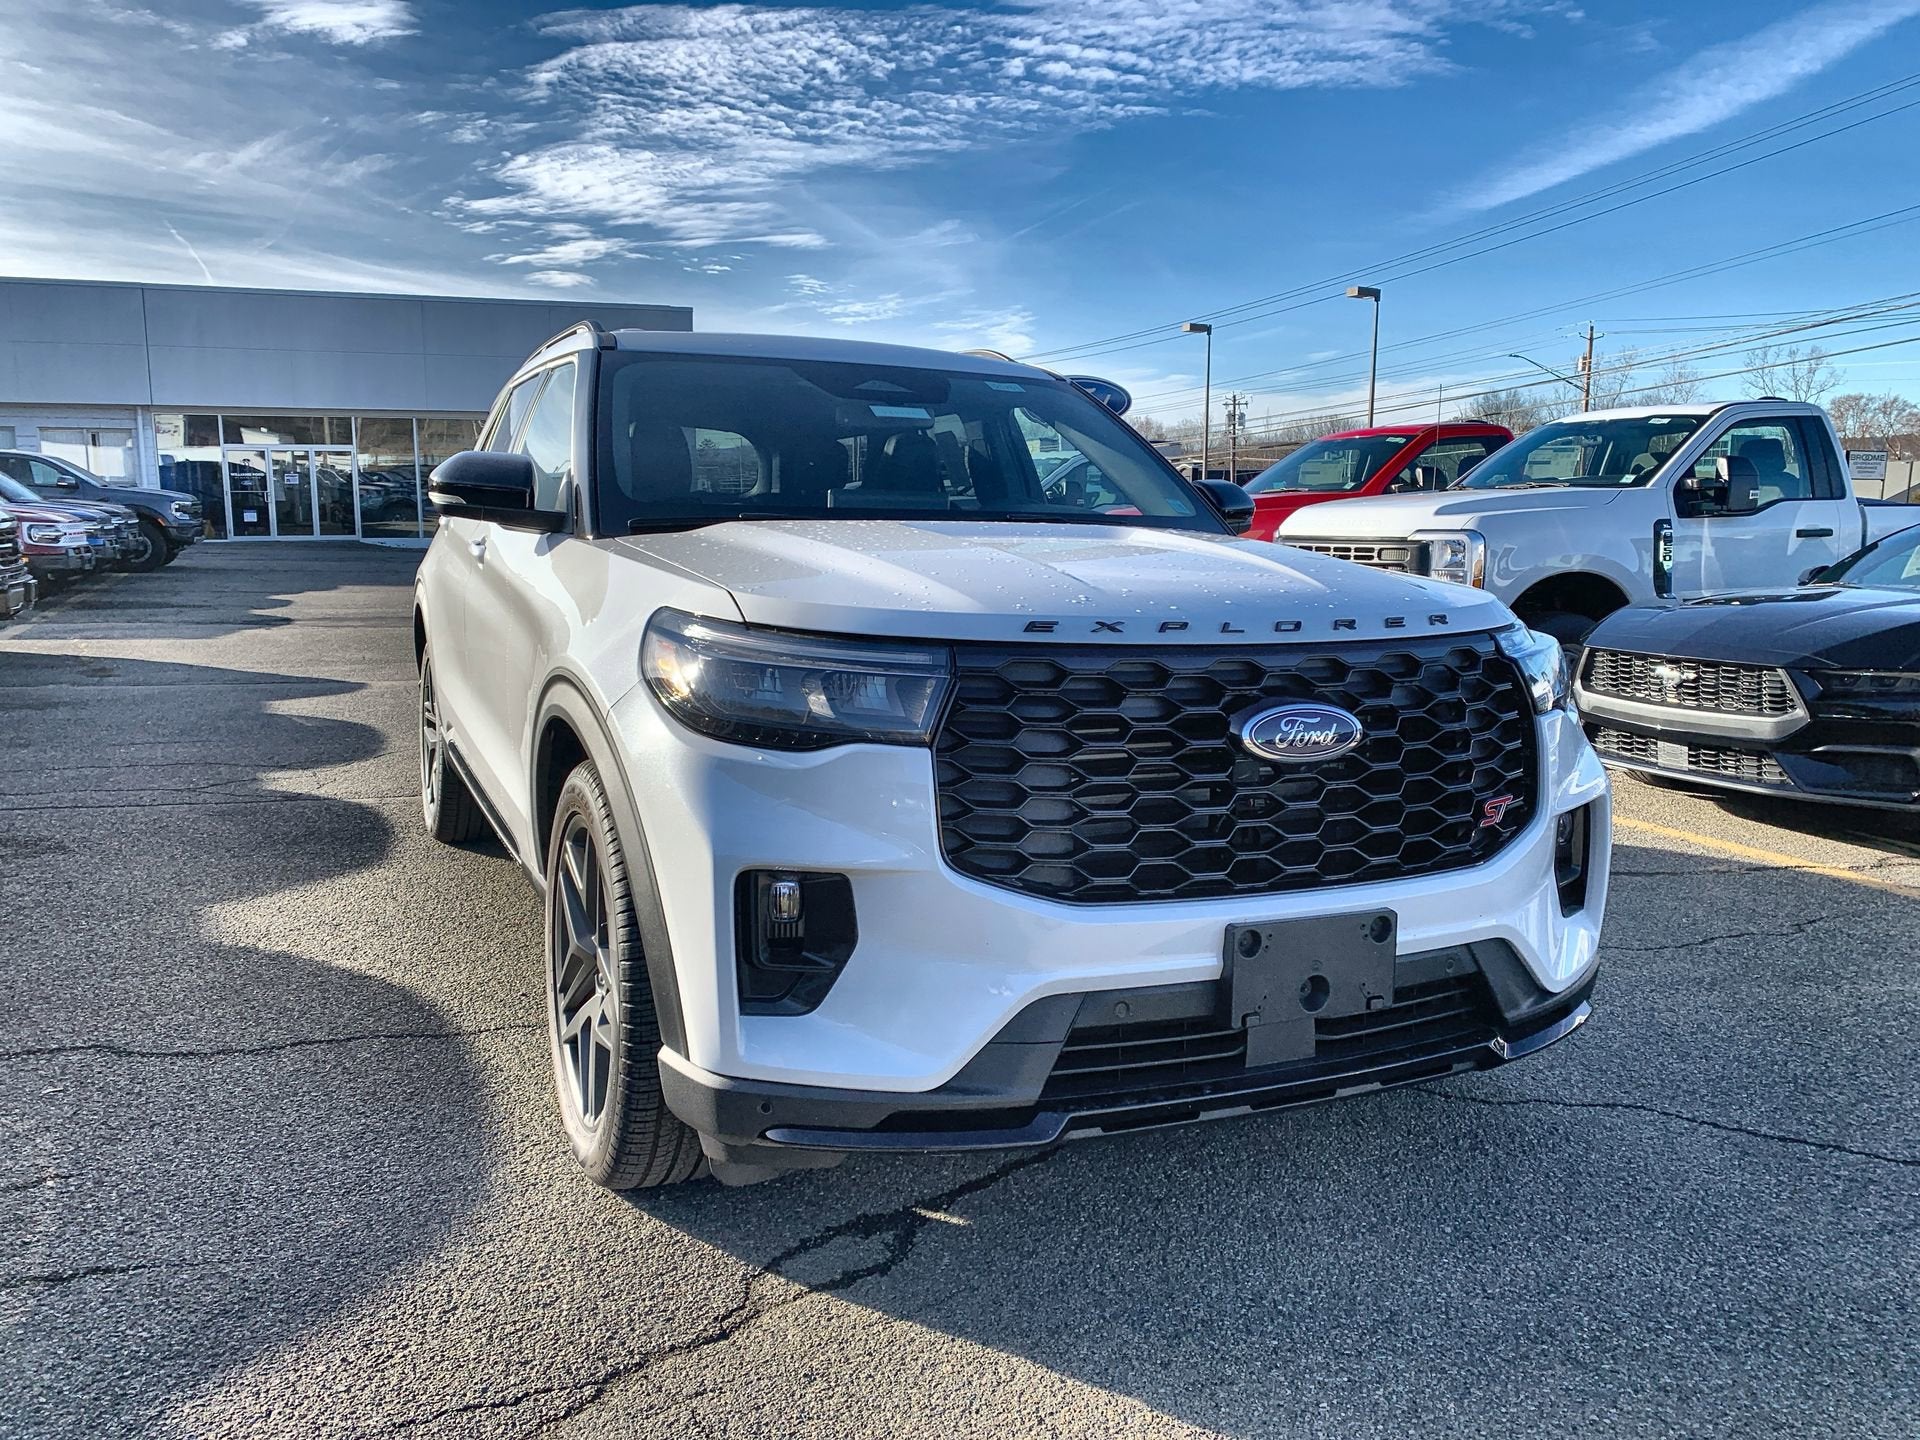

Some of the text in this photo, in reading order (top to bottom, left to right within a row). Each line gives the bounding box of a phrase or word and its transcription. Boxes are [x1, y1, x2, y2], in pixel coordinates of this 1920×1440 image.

[1850, 453, 1886, 462] BROOME
[1023, 613, 1450, 634] EXPLORER
[1275, 716, 1338, 749] Ford
[1480, 795, 1514, 827] ST
